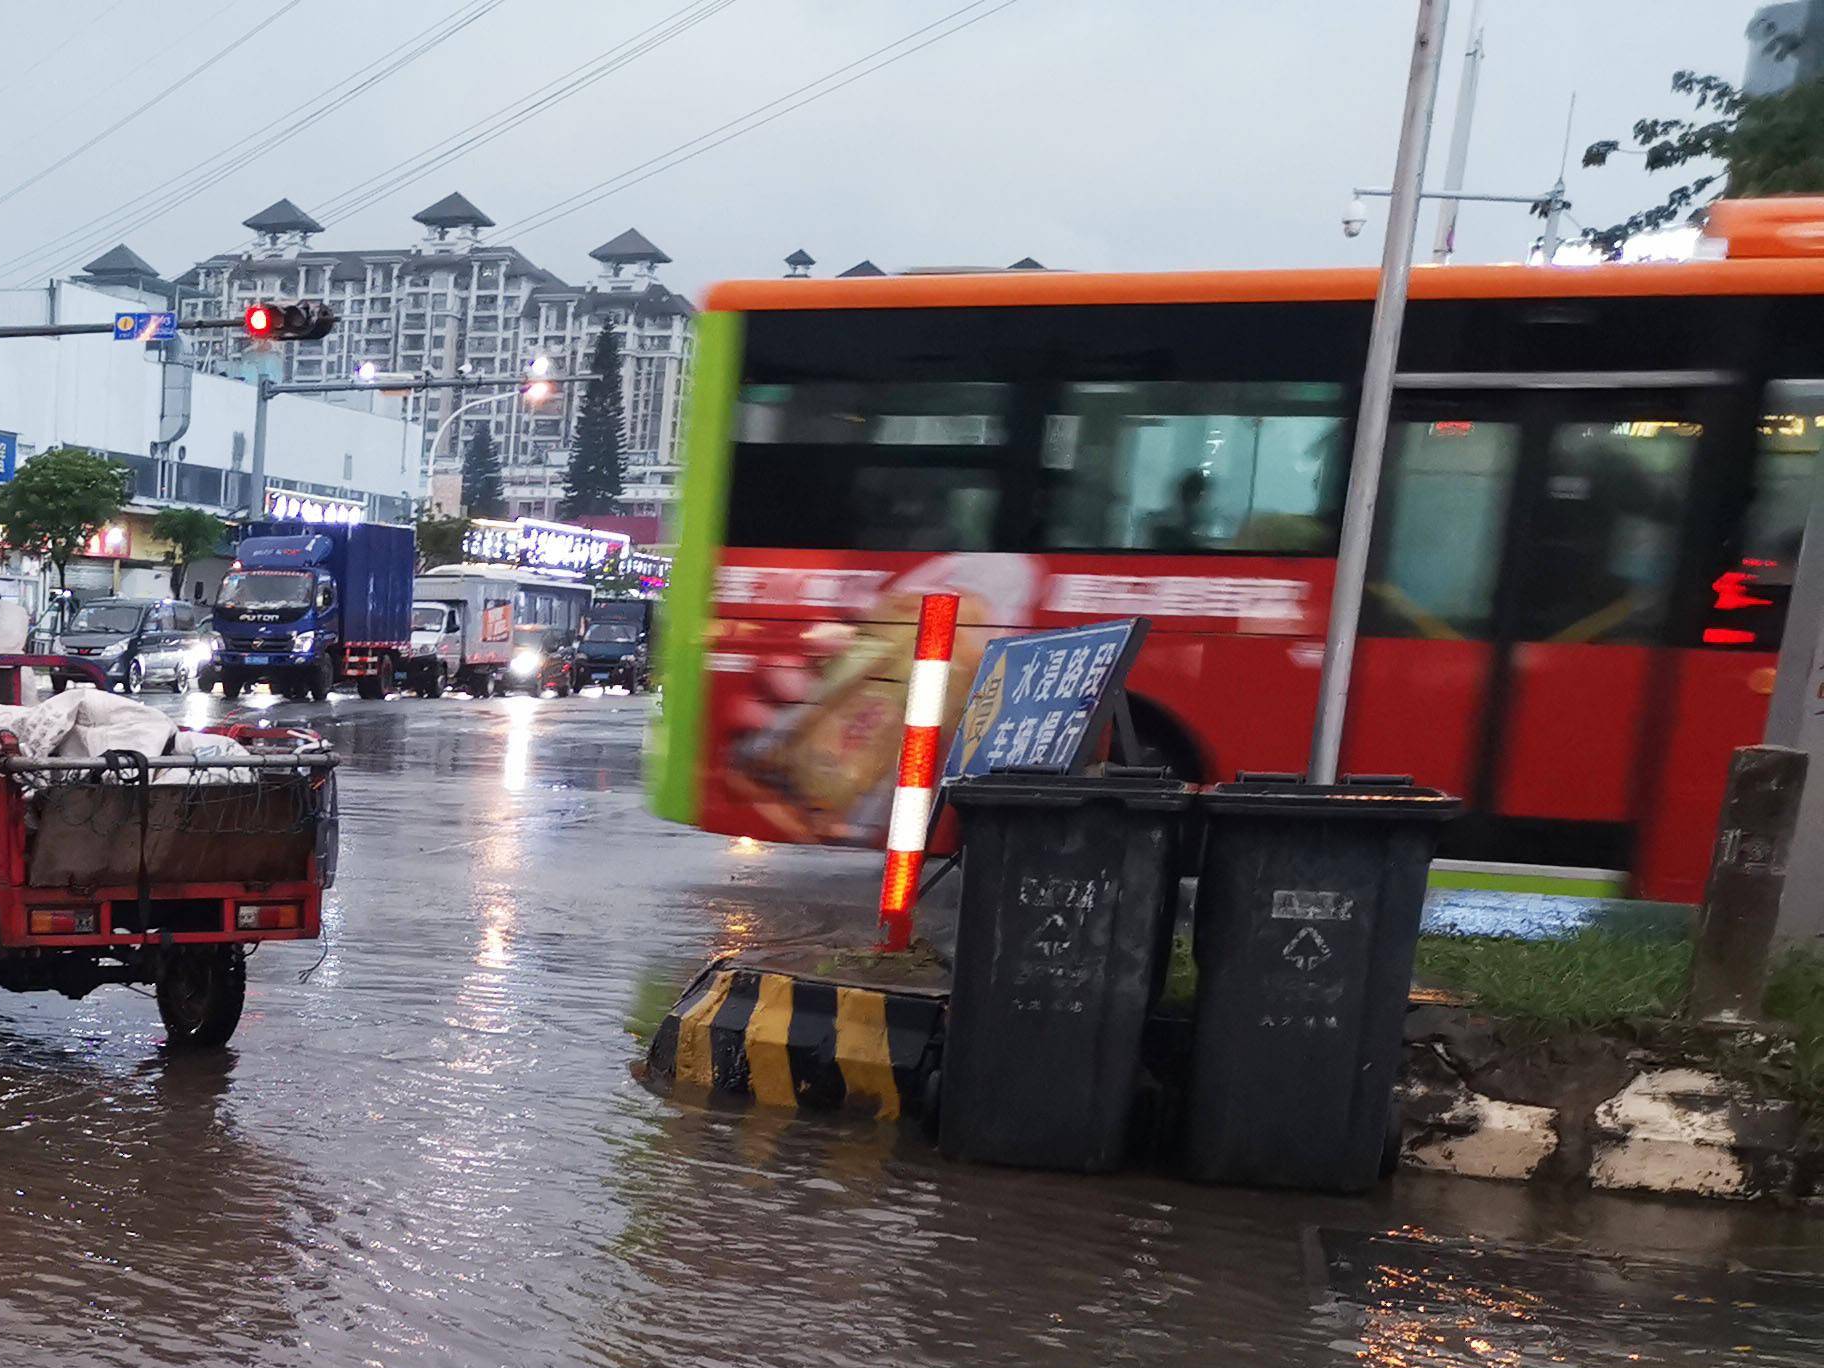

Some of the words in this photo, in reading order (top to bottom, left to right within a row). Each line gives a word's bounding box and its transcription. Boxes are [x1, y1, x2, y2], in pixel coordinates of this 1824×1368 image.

[1011, 642, 1118, 705] 水浸路段
[987, 710, 1088, 768] 车辆慢行
